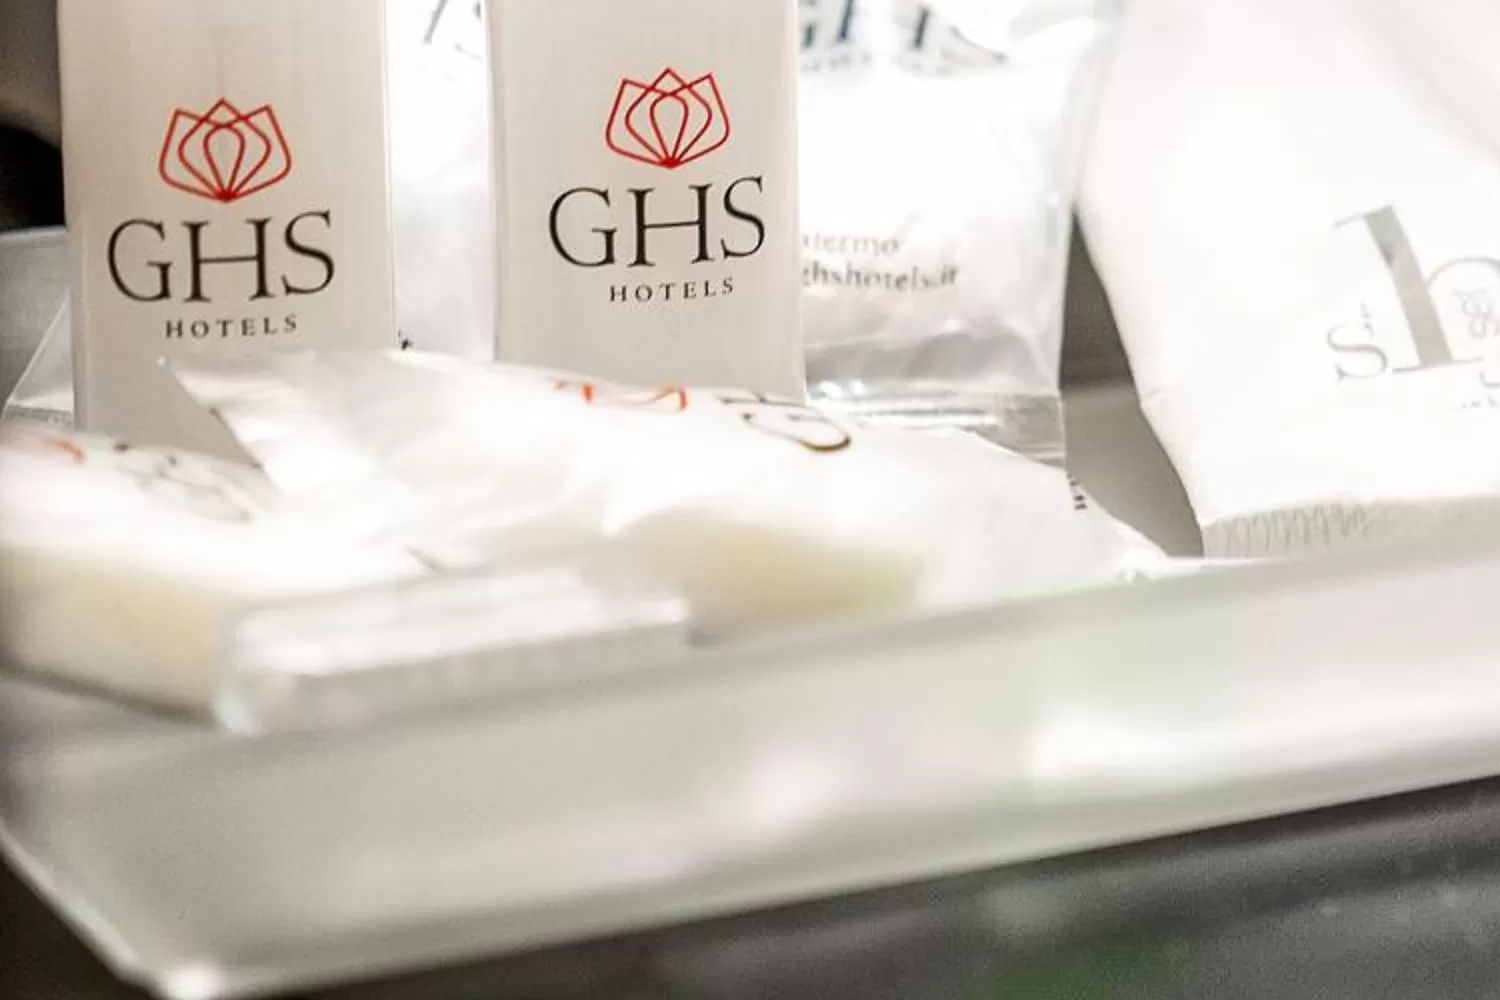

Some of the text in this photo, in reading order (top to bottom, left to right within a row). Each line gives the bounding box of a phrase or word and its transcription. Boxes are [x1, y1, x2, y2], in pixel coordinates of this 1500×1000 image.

[548, 175, 766, 268] GHS
[107, 210, 336, 303] GHS
[609, 276, 735, 303] HOTELS
[163, 312, 299, 340] HOTELS
